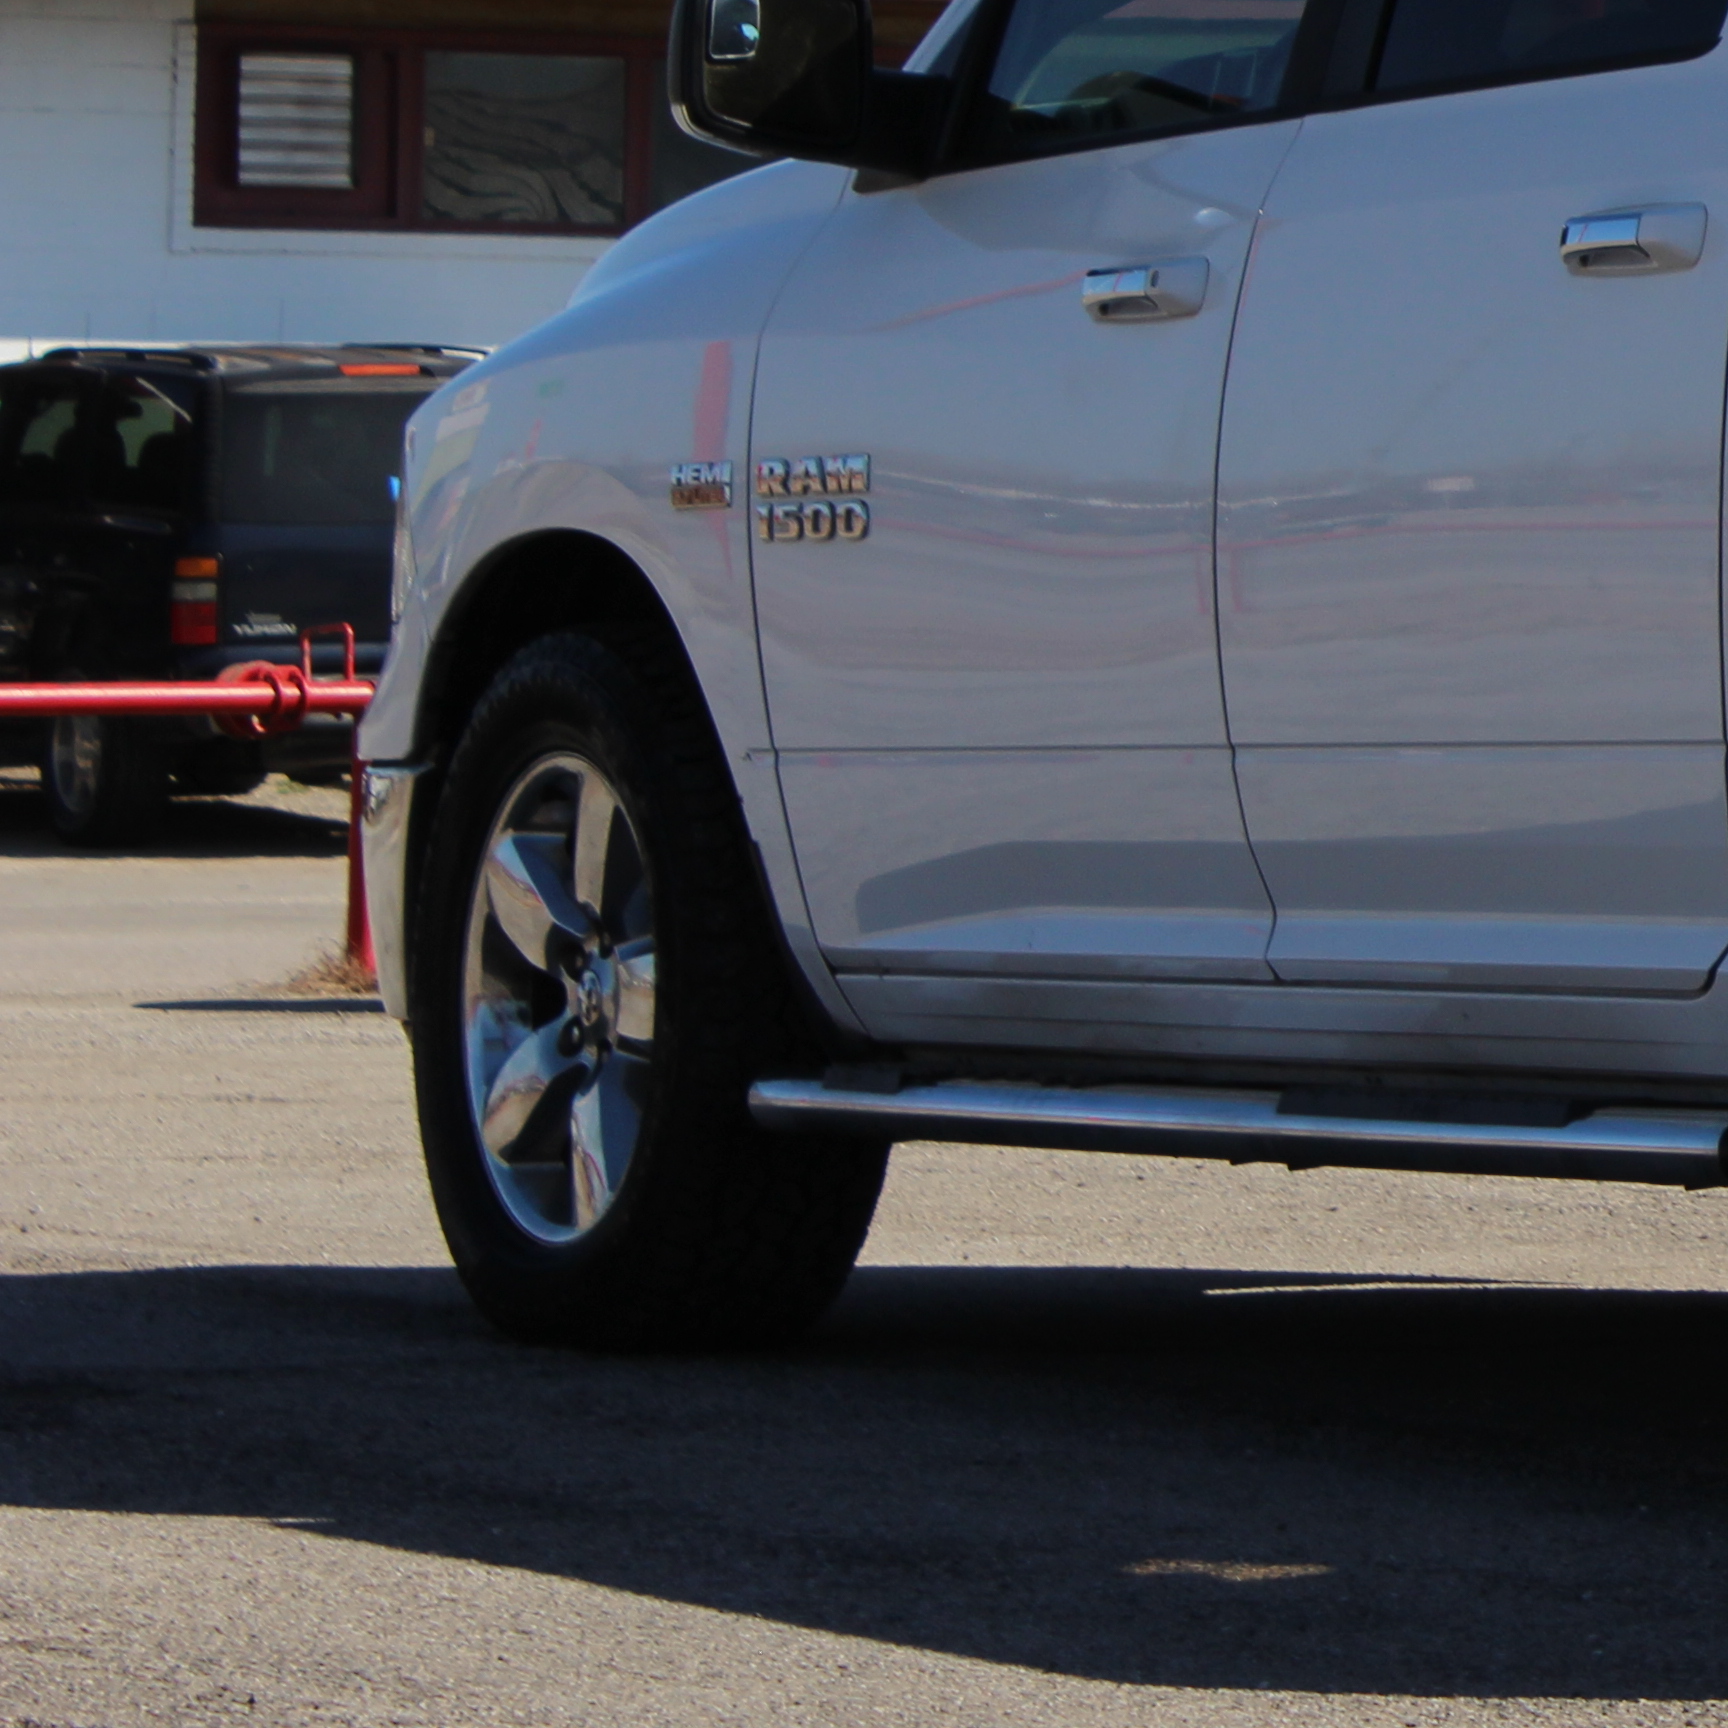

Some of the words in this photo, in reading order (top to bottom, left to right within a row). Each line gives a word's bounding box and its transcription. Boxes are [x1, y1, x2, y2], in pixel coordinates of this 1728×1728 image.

[670, 460, 732, 486] HEMI
[756, 453, 869, 496] RAM
[756, 498, 869, 542] 1500
